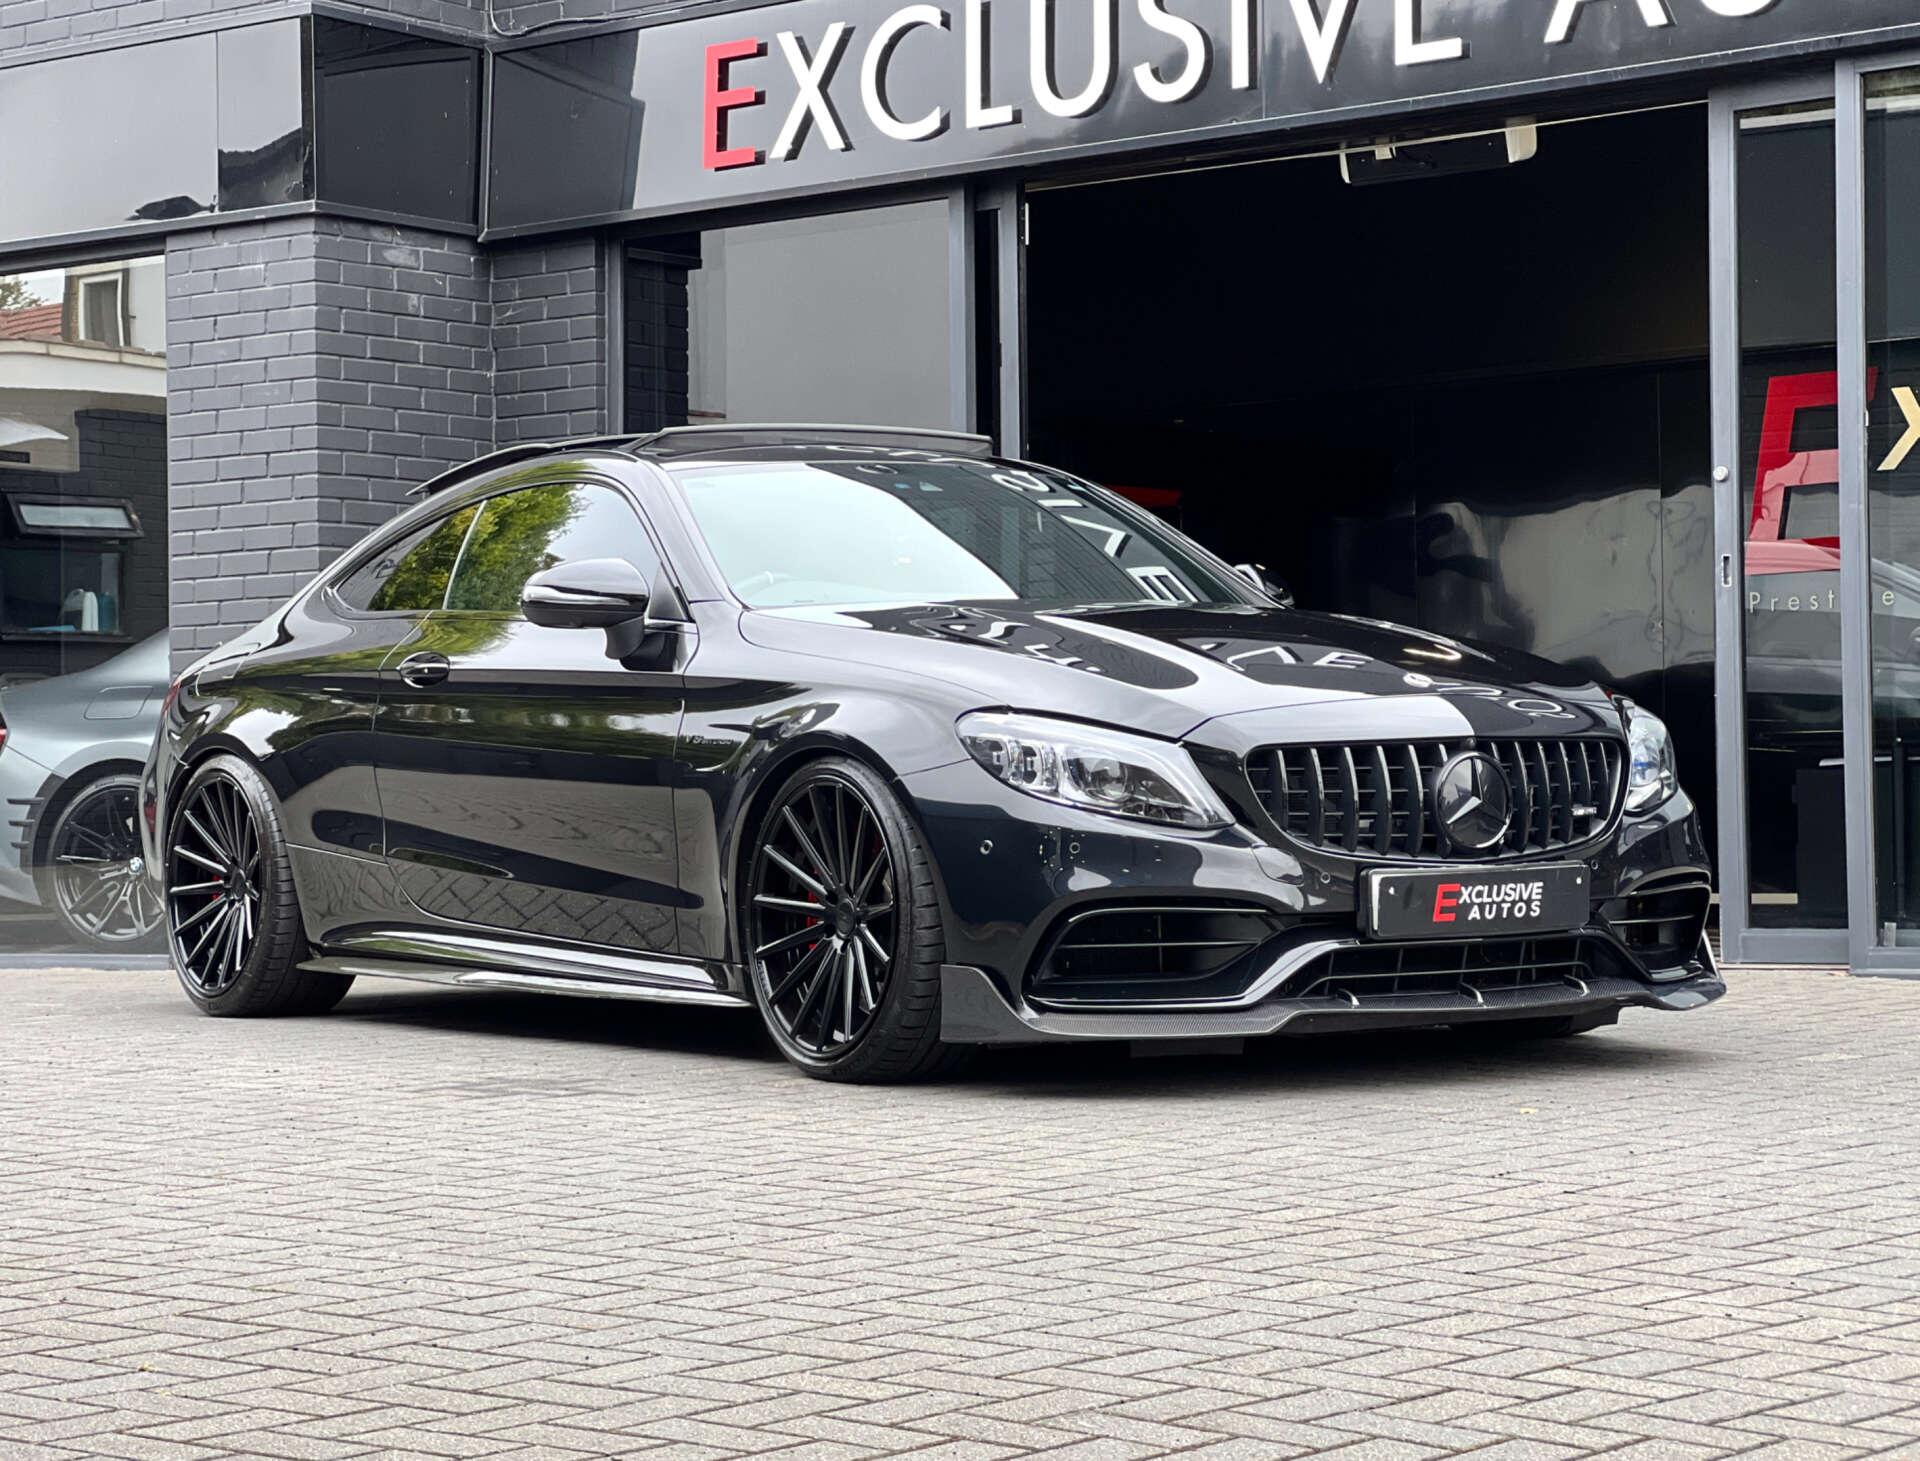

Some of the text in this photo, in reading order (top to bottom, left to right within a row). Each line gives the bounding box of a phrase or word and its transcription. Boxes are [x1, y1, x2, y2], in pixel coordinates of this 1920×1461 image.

[1749, 588, 1895, 613] Preste
[1433, 882, 1544, 922] EXCLUSIVE
[1468, 901, 1541, 921] AUTOS
